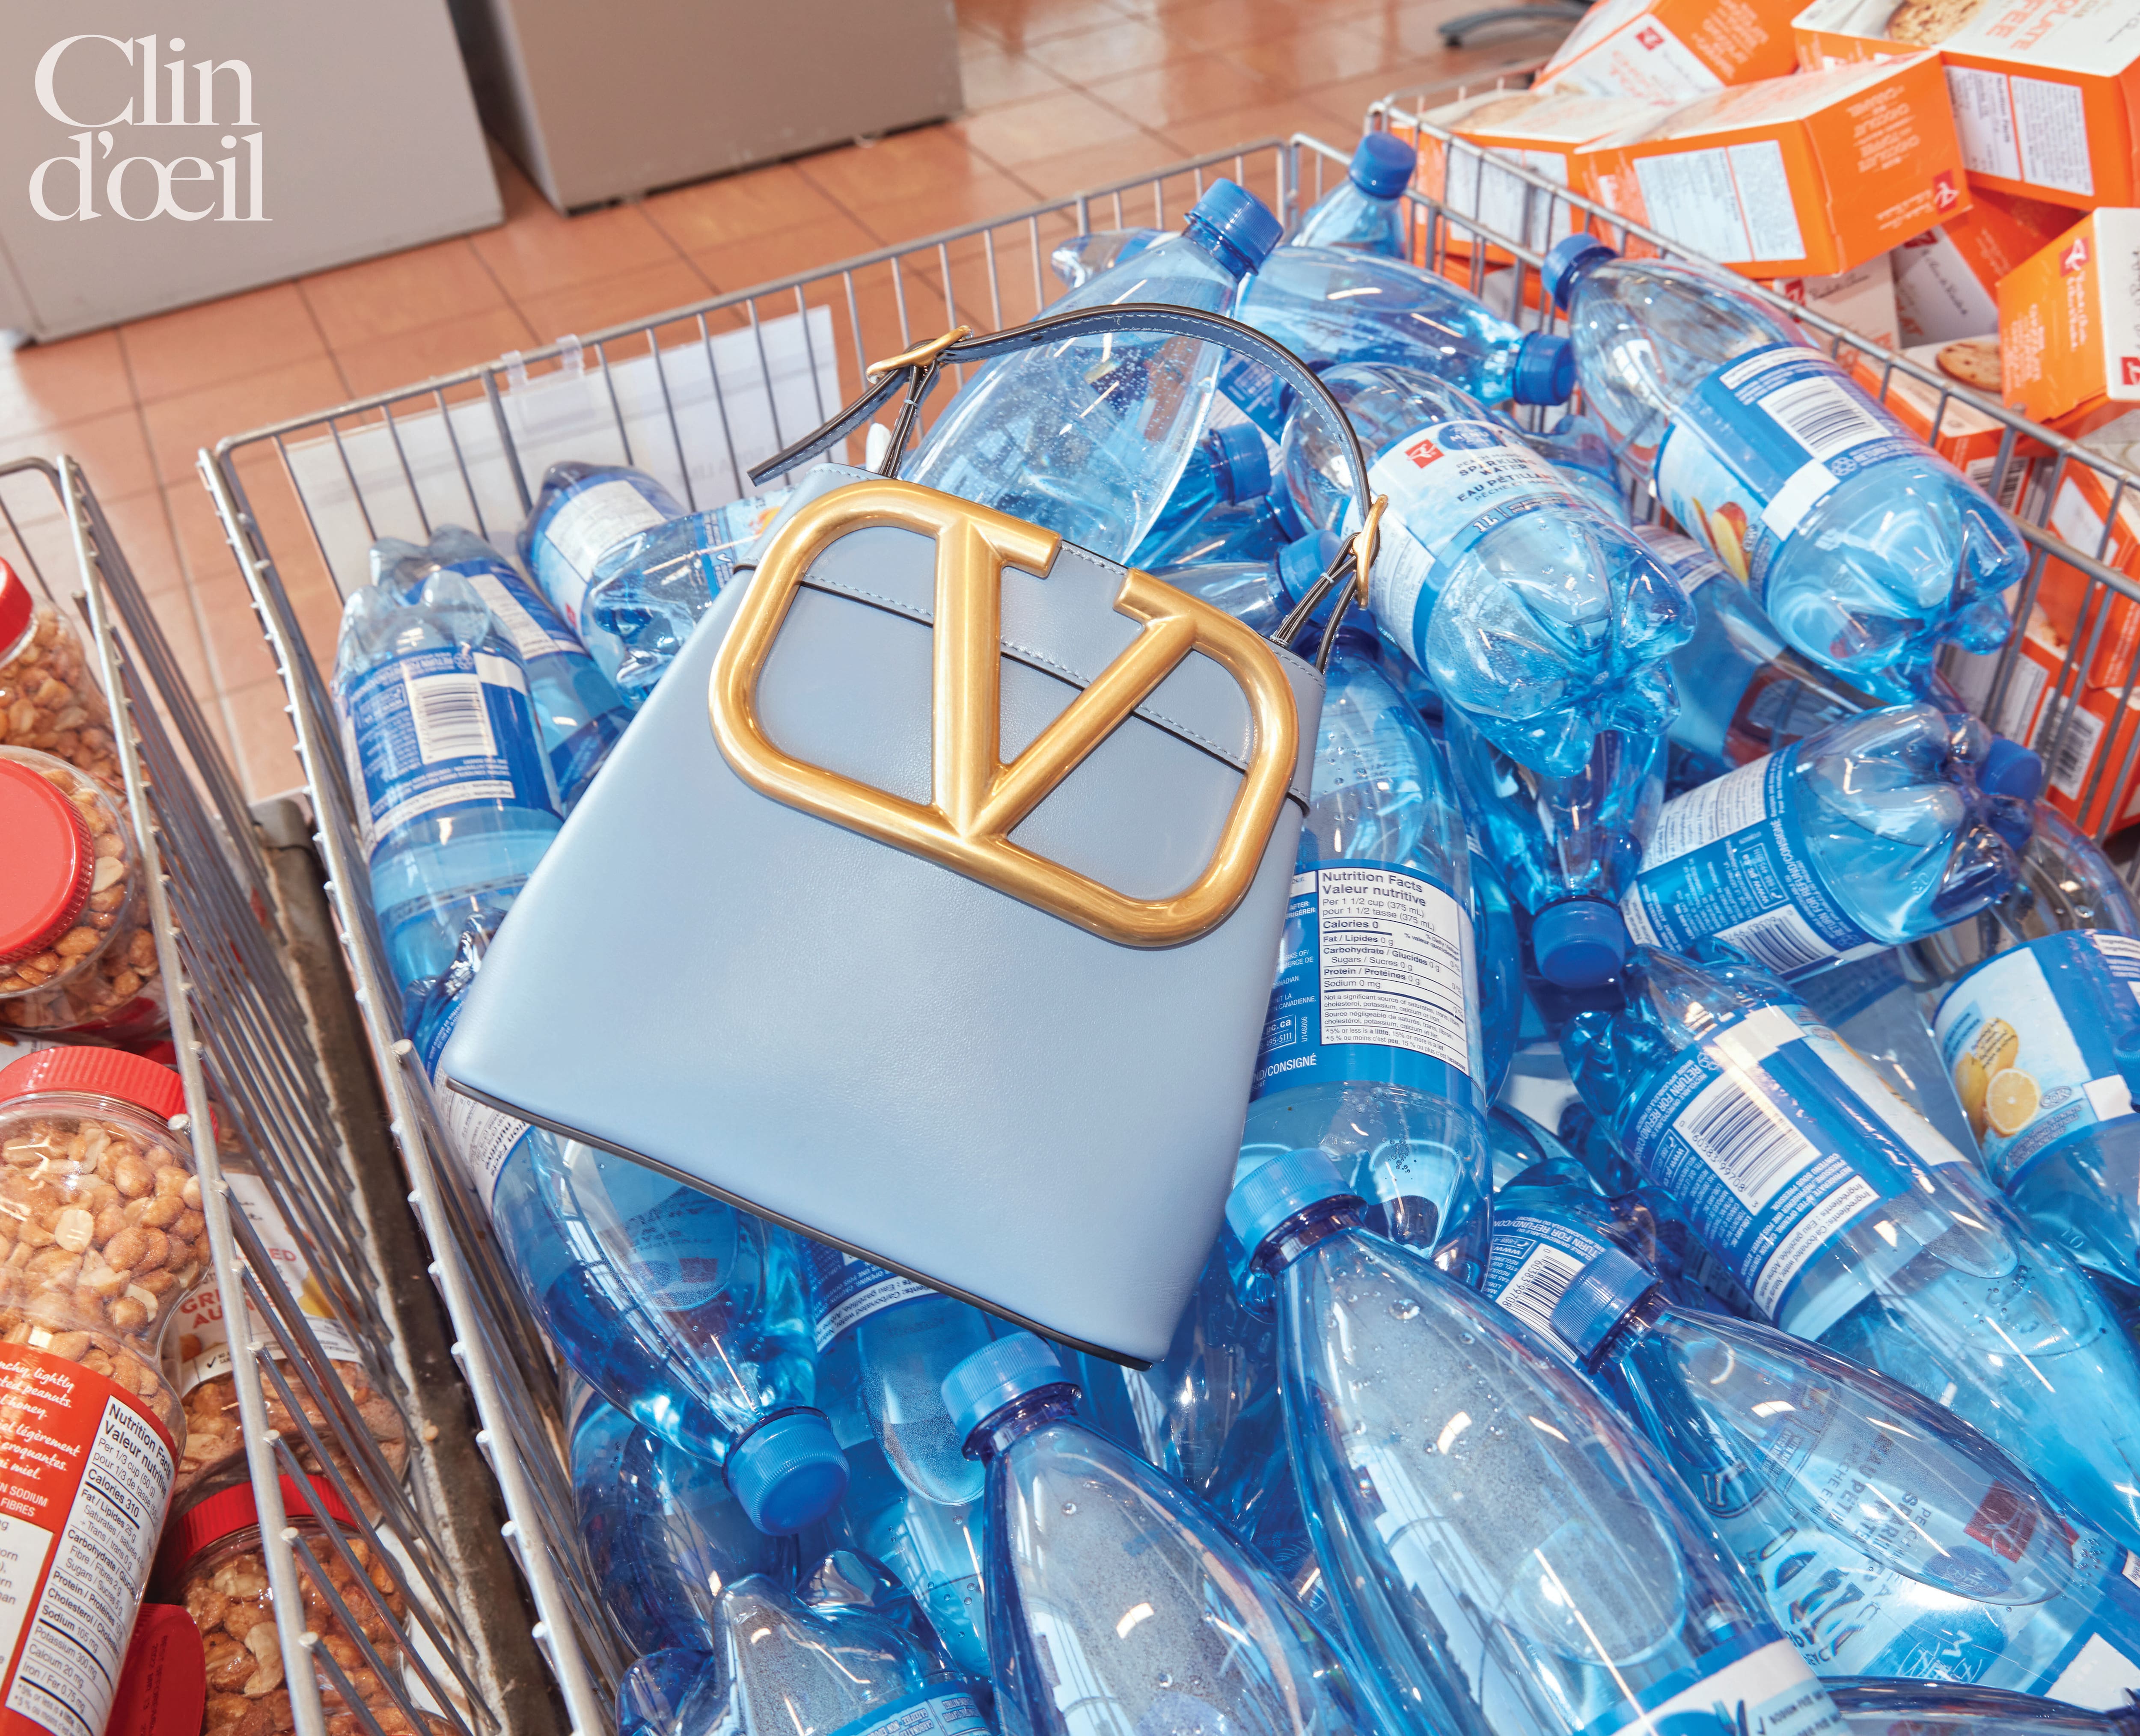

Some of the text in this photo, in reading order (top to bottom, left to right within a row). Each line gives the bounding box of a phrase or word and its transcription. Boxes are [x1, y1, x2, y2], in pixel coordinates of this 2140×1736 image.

[1457, 484, 1485, 503] EAU
[1323, 871, 1423, 893] Nutrition Facts
[1323, 884, 1426, 906] Valeur nutritive
[1804, 894, 1823, 915] FOR
[1323, 908, 1343, 916] pour
[1373, 908, 1397, 918] tasse
[1400, 912, 1418, 923] (375
[1421, 921, 1435, 932] mL)
[1387, 901, 1406, 911] (375
[1409, 907, 1424, 918] mL)
[1323, 920, 1369, 929] Calories
[1816, 911, 1845, 938] RETURN
[1323, 947, 1384, 956] Carbohydrate
[1392, 950, 1427, 966] Glucides
[1370, 957, 1397, 967] Sucres
[1364, 968, 1406, 980] Protéines
[1279, 996, 1316, 1010] CANADIENNE.
[1655, 1064, 1702, 1111] RETURN FOR
[1691, 1131, 1720, 1164] 60383
[1716, 1161, 1746, 1195] 99708
[1794, 1168, 1818, 1190] SOUS
[1813, 1165, 1854, 1197] REFRIGERATE
[1818, 1181, 1864, 1222] Ingrédients
[1824, 1187, 1872, 1229] Ingredients:
[1550, 1226, 1572, 1244] FOR
[1800, 1218, 1818, 1235] Eau
[1794, 1224, 1829, 1255] Carbonated
[1520, 1258, 1541, 1283] 60383
[1501, 1283, 1525, 1308] 99708
[33, 1368, 75, 1393] lightly
[21, 1383, 72, 1408] peanuts.
[7, 1398, 48, 1420] honey.
[16, 1423, 82, 1457] légèrement
[109, 1403, 171, 1481] Nutrition Facts
[2, 1441, 68, 1472] croquantes.
[98, 1437, 155, 1498] Per 1/3 cup (50 g)
[105, 1420, 167, 1499] Valeur nutritive
[10, 1463, 41, 1481] miel.
[93, 1452, 151, 1508] pour 1/3 de tasse
[9, 1485, 49, 1508] SODIUM
[88, 1469, 139, 1516] Calories 310
[0, 1497, 36, 1518] FIBRES
[81, 1489, 95, 1504] Fat
[100, 1502, 125, 1528] Lipides
[125, 1525, 133, 1537] 25
[132, 1534, 136, 1543] g
[70, 1545, 89, 1564] Fibre
[94, 1564, 113, 1585] Fibres
[113, 1582, 118, 1590] 2
[117, 1588, 122, 1597] g
[53, 1570, 83, 1596] Protein
[89, 1594, 115, 1626] Protéines
[42, 1605, 98, 1653] Sodium 105 mg
[35, 1626, 97, 1680] Potassium 300 mg
[29, 1644, 84, 1689] Calcium 20 mg
[22, 1661, 40, 1678] Iron
[46, 1674, 60, 1688] Fer
[61, 1684, 76, 1702] 0.75
[76, 1698, 85, 1714] mg
